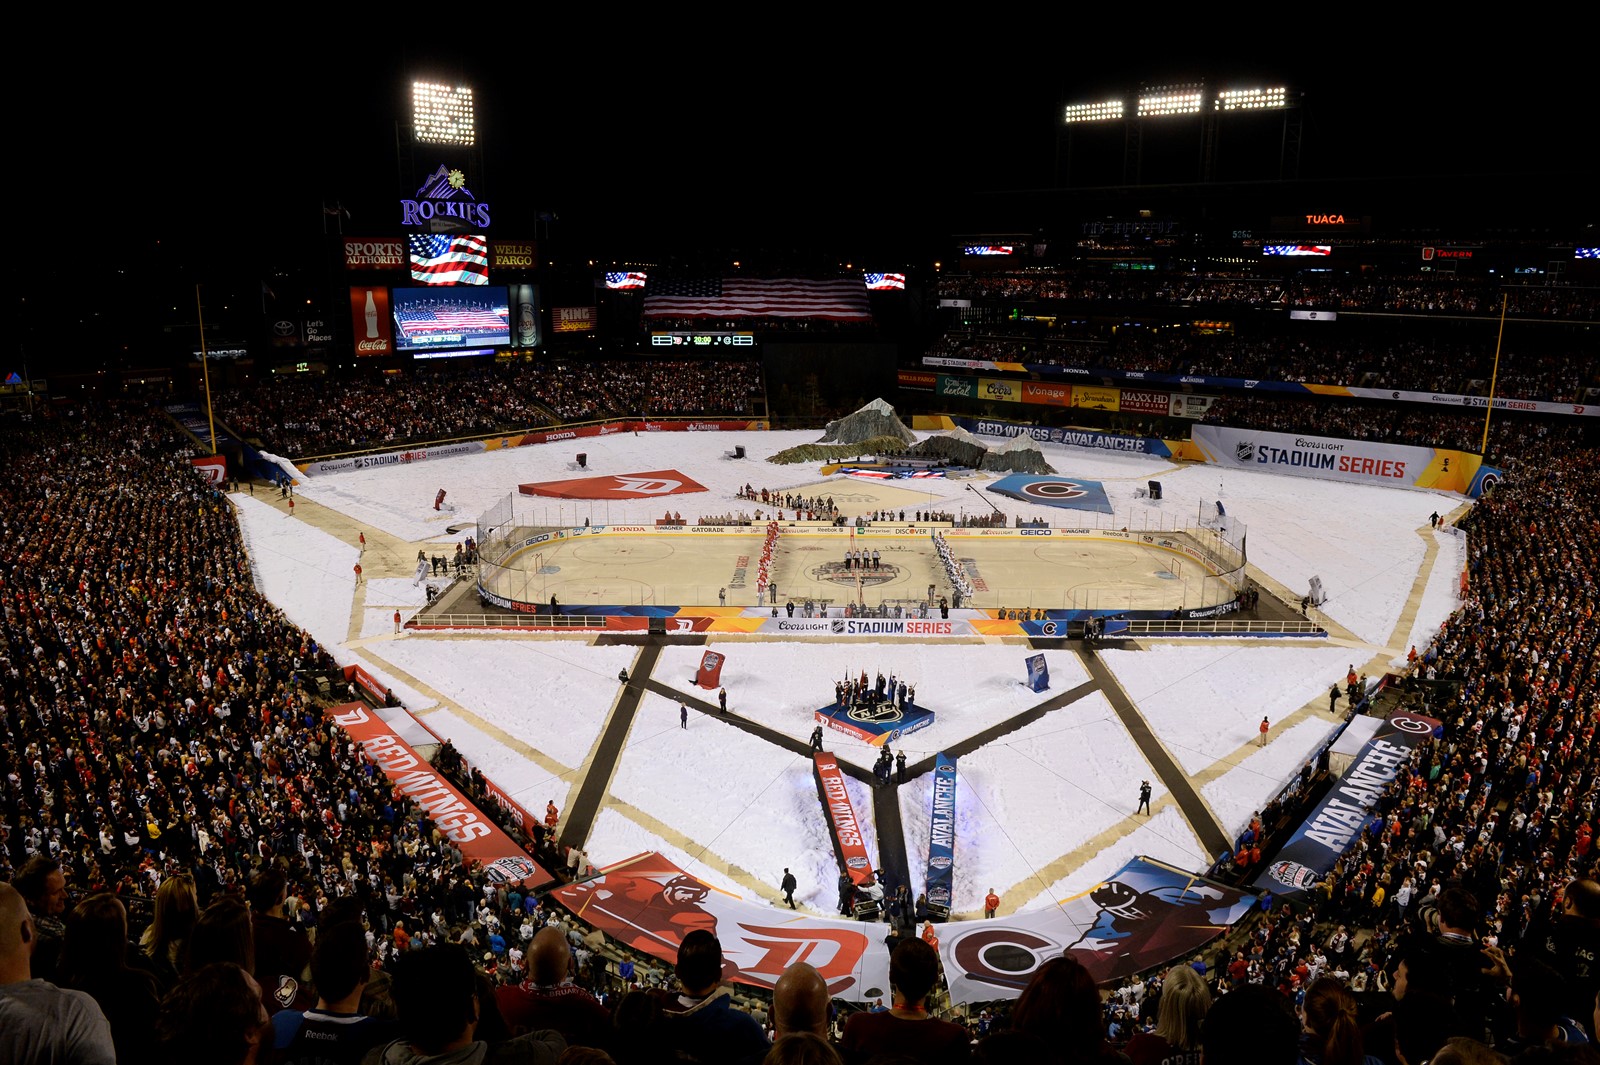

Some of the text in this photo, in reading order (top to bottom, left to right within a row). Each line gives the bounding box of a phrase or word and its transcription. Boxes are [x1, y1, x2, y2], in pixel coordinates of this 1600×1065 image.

[401, 199, 491, 228] ROCKIES
[1306, 215, 1345, 224] TUACA
[345, 243, 403, 256] SPORTS
[494, 245, 532, 255] WELLS
[496, 256, 532, 266] FARGO
[561, 308, 590, 320] KING
[308, 334, 332, 342] Places
[943, 386, 971, 397] dental
[987, 382, 1012, 396] Coors
[1027, 385, 1065, 398] Vonage
[1121, 391, 1168, 403] MAXX HD
[1507, 401, 1537, 410] SERIES
[546, 431, 576, 441] HONDA
[976, 420, 1049, 441] RED WINGS
[1063, 431, 1145, 451] AVALANCHE
[1295, 438, 1344, 451] Coors LIGHT
[364, 455, 399, 468] STADIUM
[400, 451, 427, 463] SRIES
[1257, 446, 1335, 470] STADIUM
[1339, 456, 1405, 479] SERIES
[525, 534, 550, 546] GEICO
[778, 620, 828, 631] Coors LIGHT
[848, 620, 904, 634] STADIUM
[906, 622, 952, 634] SERIES
[831, 722, 844, 733] RED
[356, 734, 492, 843] RED WINGS
[1304, 738, 1412, 854] AVALANCHE
[822, 775, 862, 847] RED WINGS
[931, 777, 954, 849] AVALANCHE
[305, 1029, 339, 1042] Reebok
